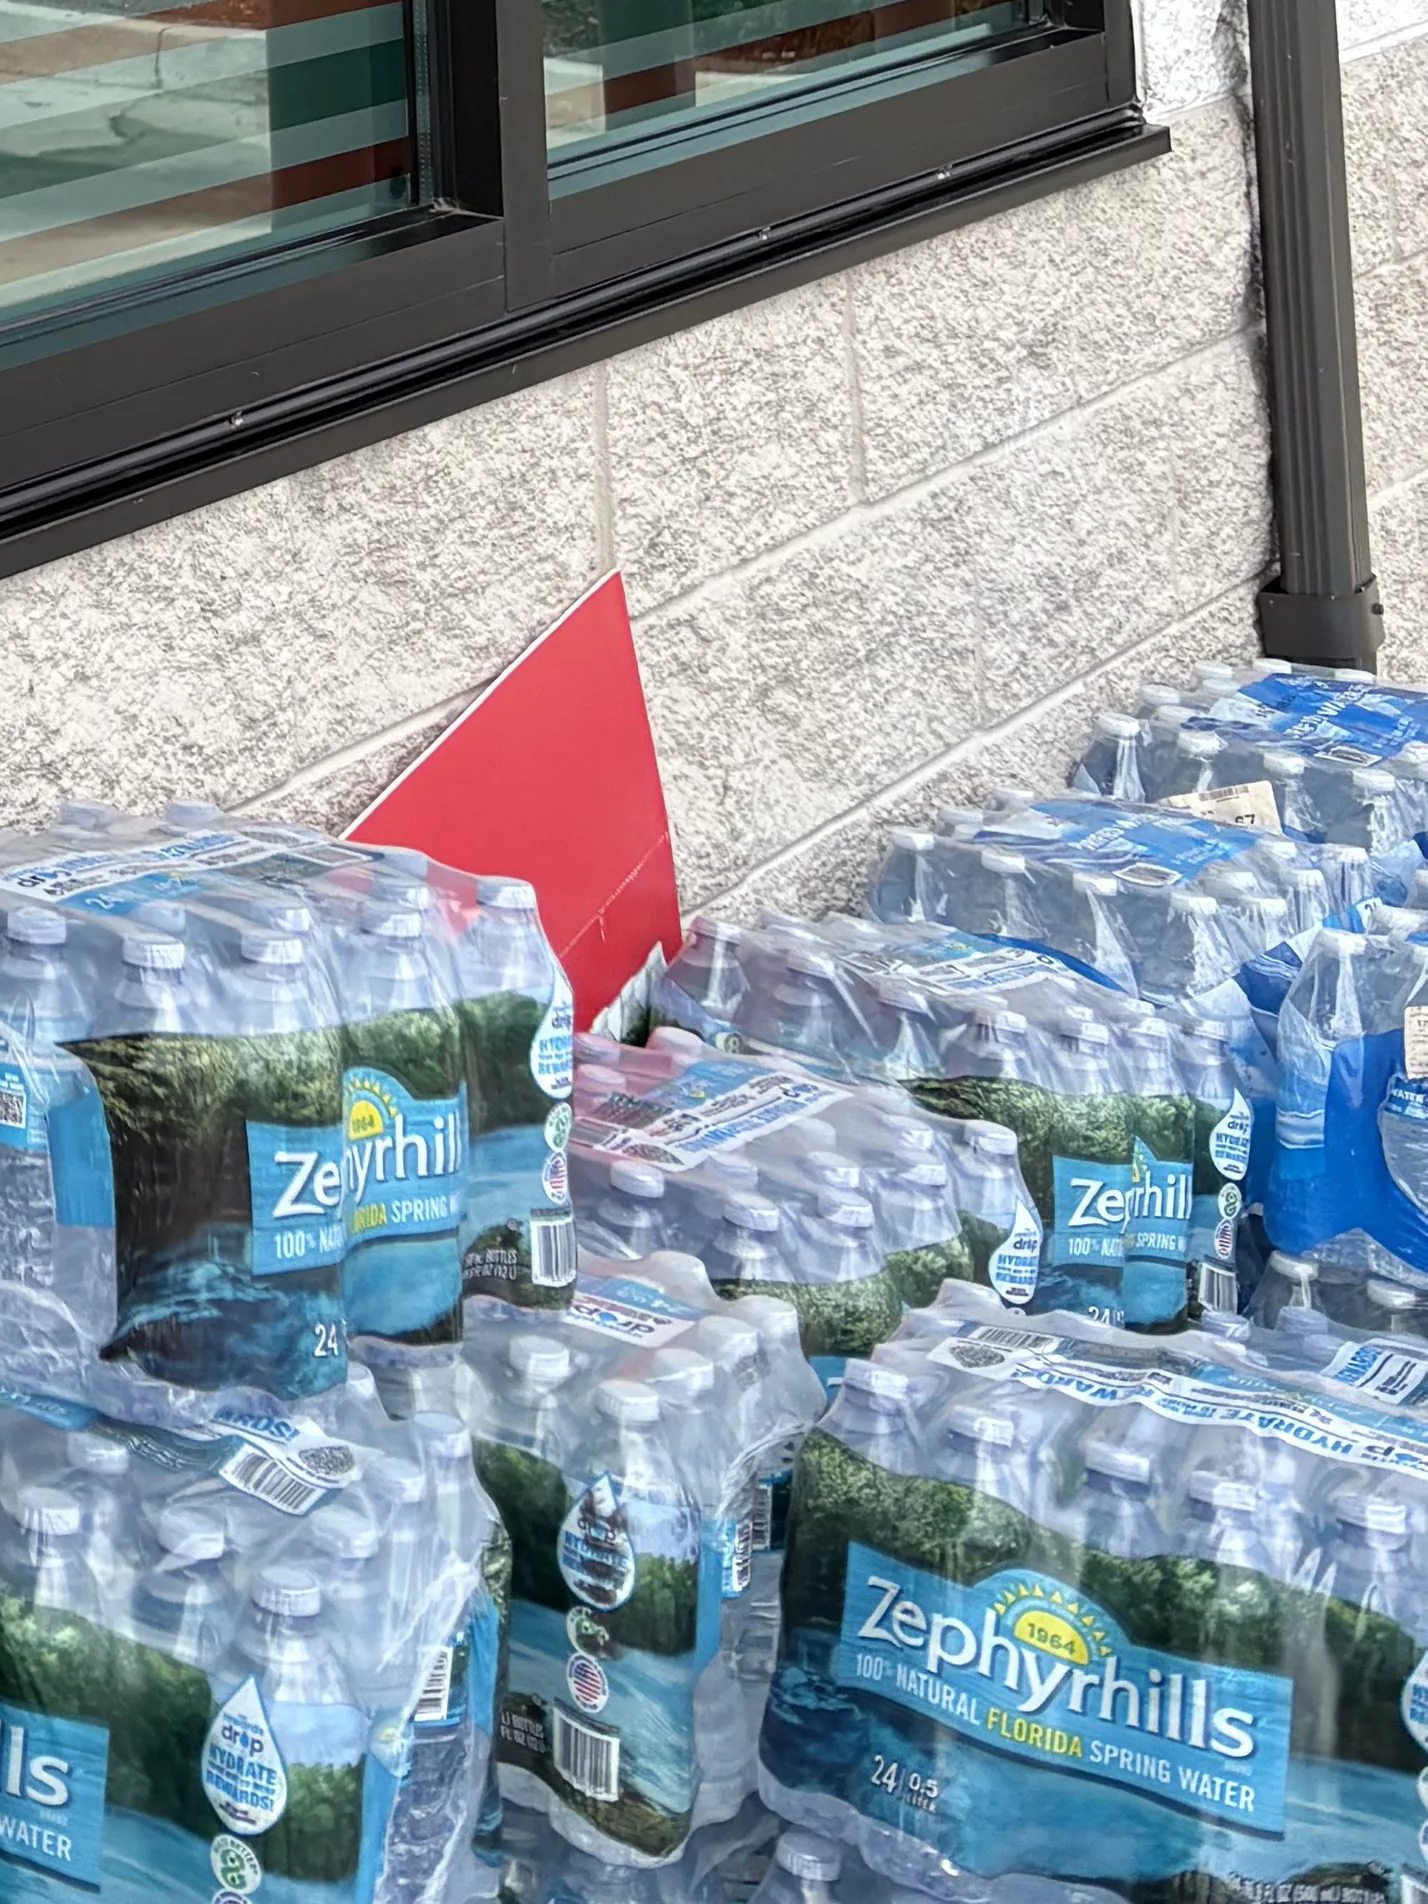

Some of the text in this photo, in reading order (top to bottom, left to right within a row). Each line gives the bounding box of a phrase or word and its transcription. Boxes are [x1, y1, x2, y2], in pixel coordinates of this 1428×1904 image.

[391, 1196, 447, 1224] SPRING
[1136, 1232, 1176, 1251] SPRING
[313, 1322, 339, 1357] 24
[1025, 1621, 1077, 1656] 1964
[857, 1575, 1256, 1760] Zephyrhills
[221, 1723, 265, 1755] drop
[895, 1663, 982, 1728] NATURAL
[986, 1708, 1084, 1759] FLORIDA
[1089, 1740, 1173, 1784] SPRING
[1177, 1765, 1256, 1813] WATER
[208, 1743, 278, 1789] HYDRATE
[870, 1755, 939, 1799] 24 0.5
